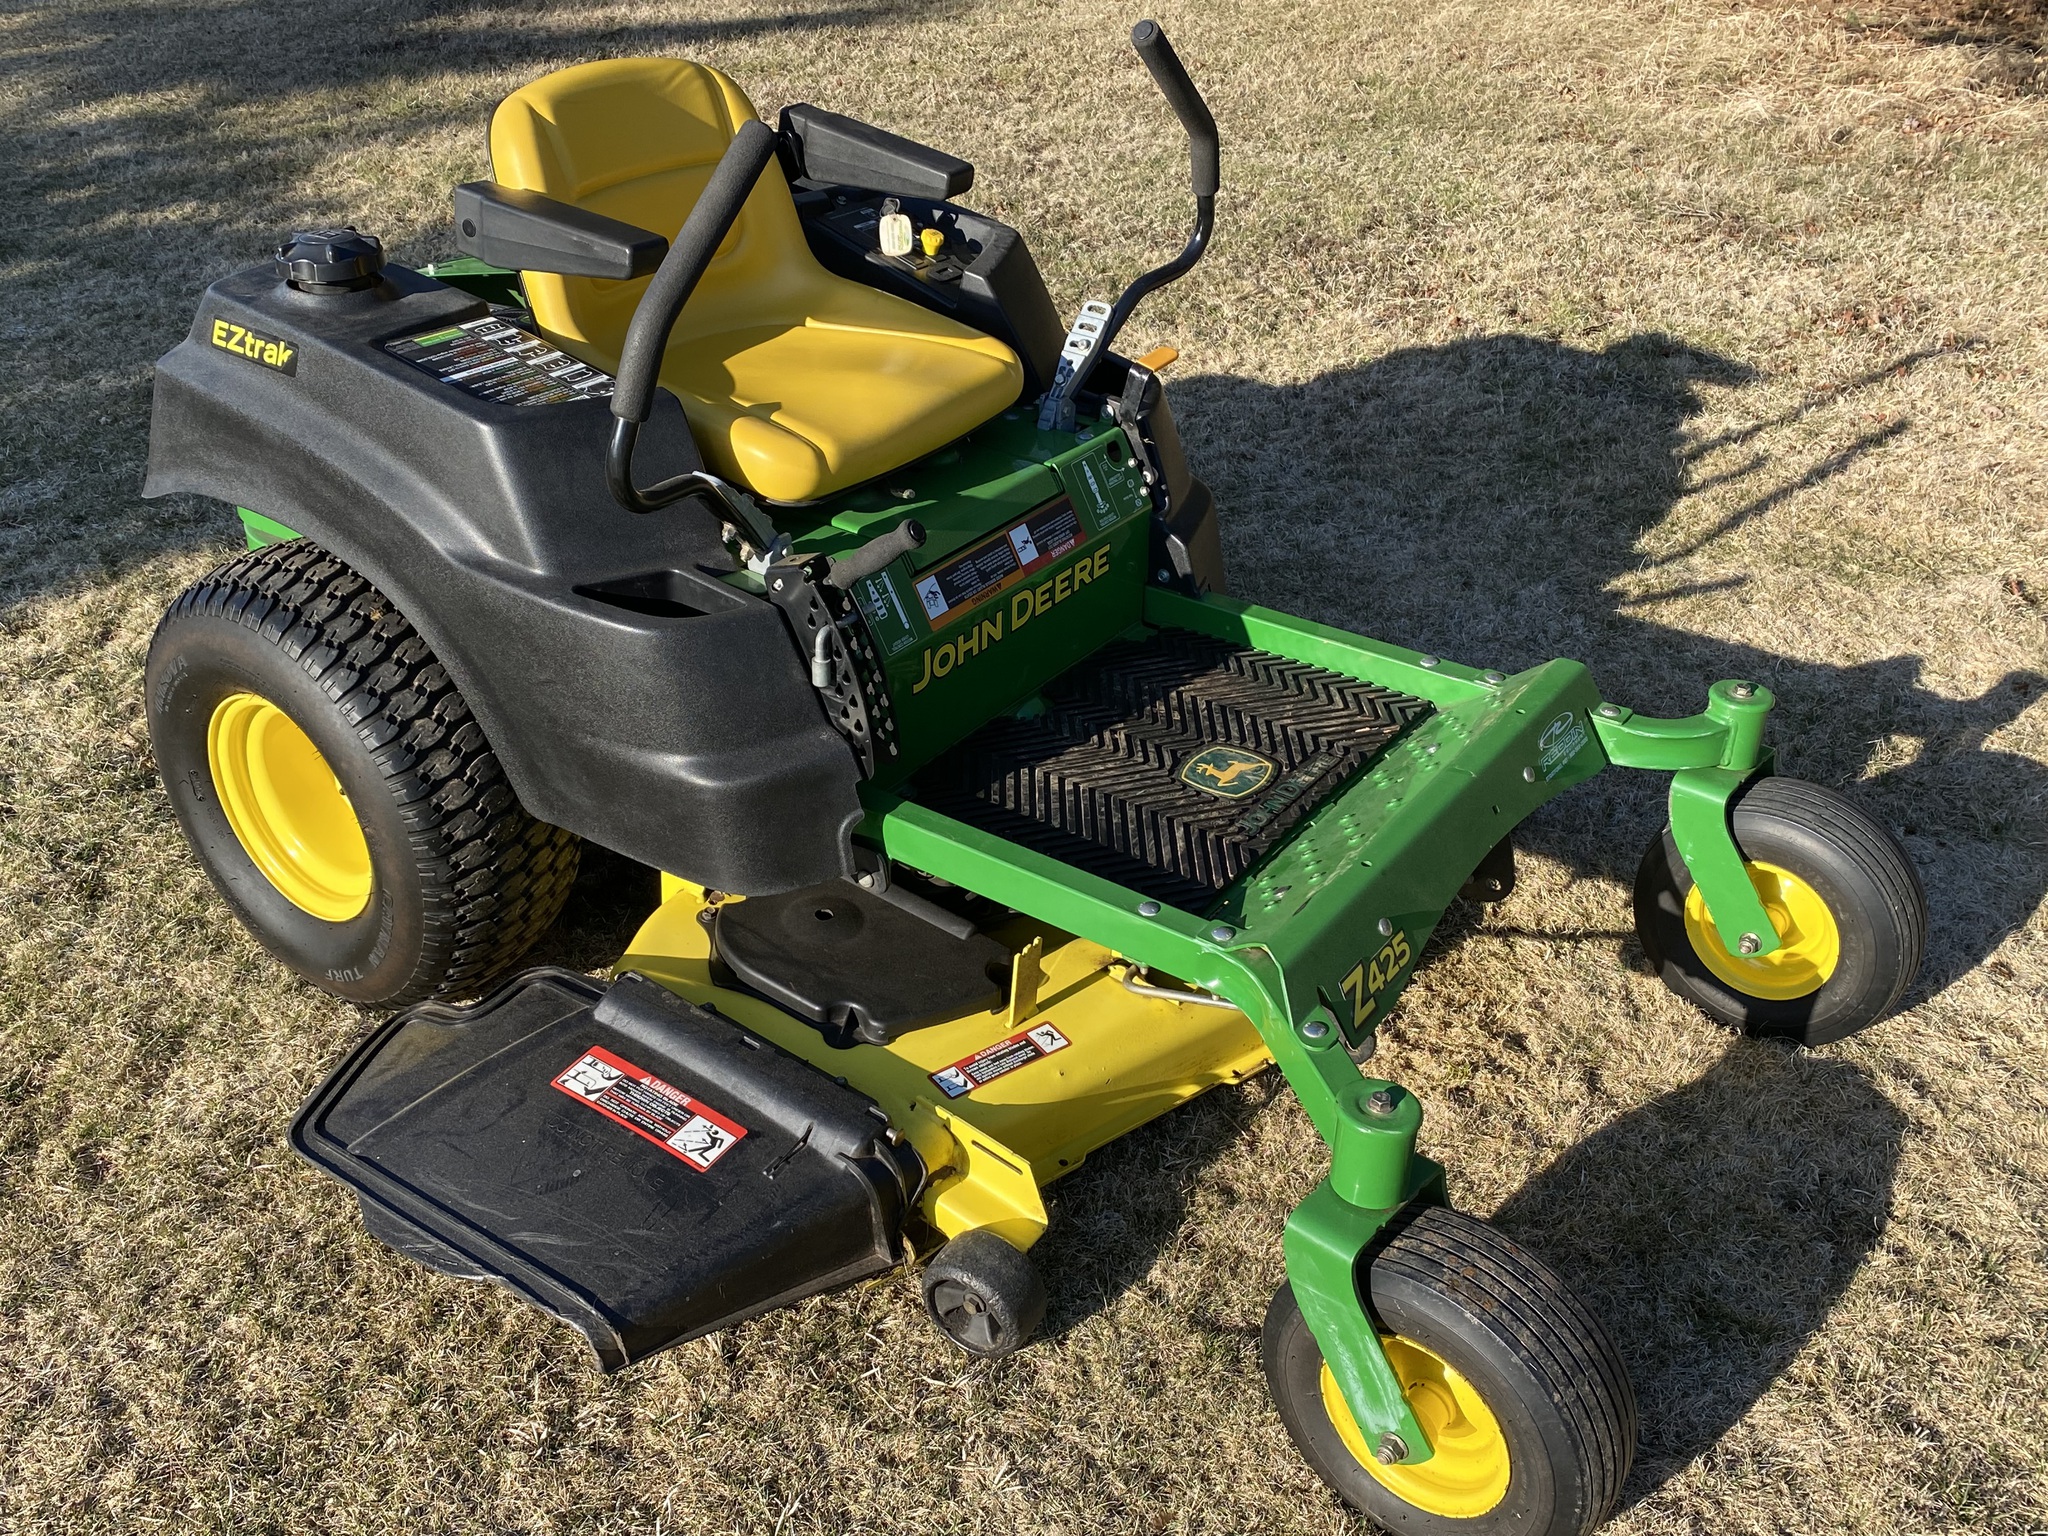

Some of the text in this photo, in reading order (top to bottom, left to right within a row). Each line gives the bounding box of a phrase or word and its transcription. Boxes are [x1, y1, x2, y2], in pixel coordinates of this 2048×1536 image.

[212, 319, 294, 367] EZtrak
[1050, 540, 1070, 557] DANGER
[970, 585, 998, 605] WARNING
[912, 610, 1003, 694] JOHN
[1011, 543, 1110, 632] DEERE
[1235, 795, 1290, 837] JOHN
[325, 966, 365, 983] TURF
[1341, 930, 1411, 1029] Z425
[980, 1040, 1012, 1057] DANGER
[628, 1090, 671, 1116] THROWN OBJECTS
[650, 1080, 691, 1106] DANGER
